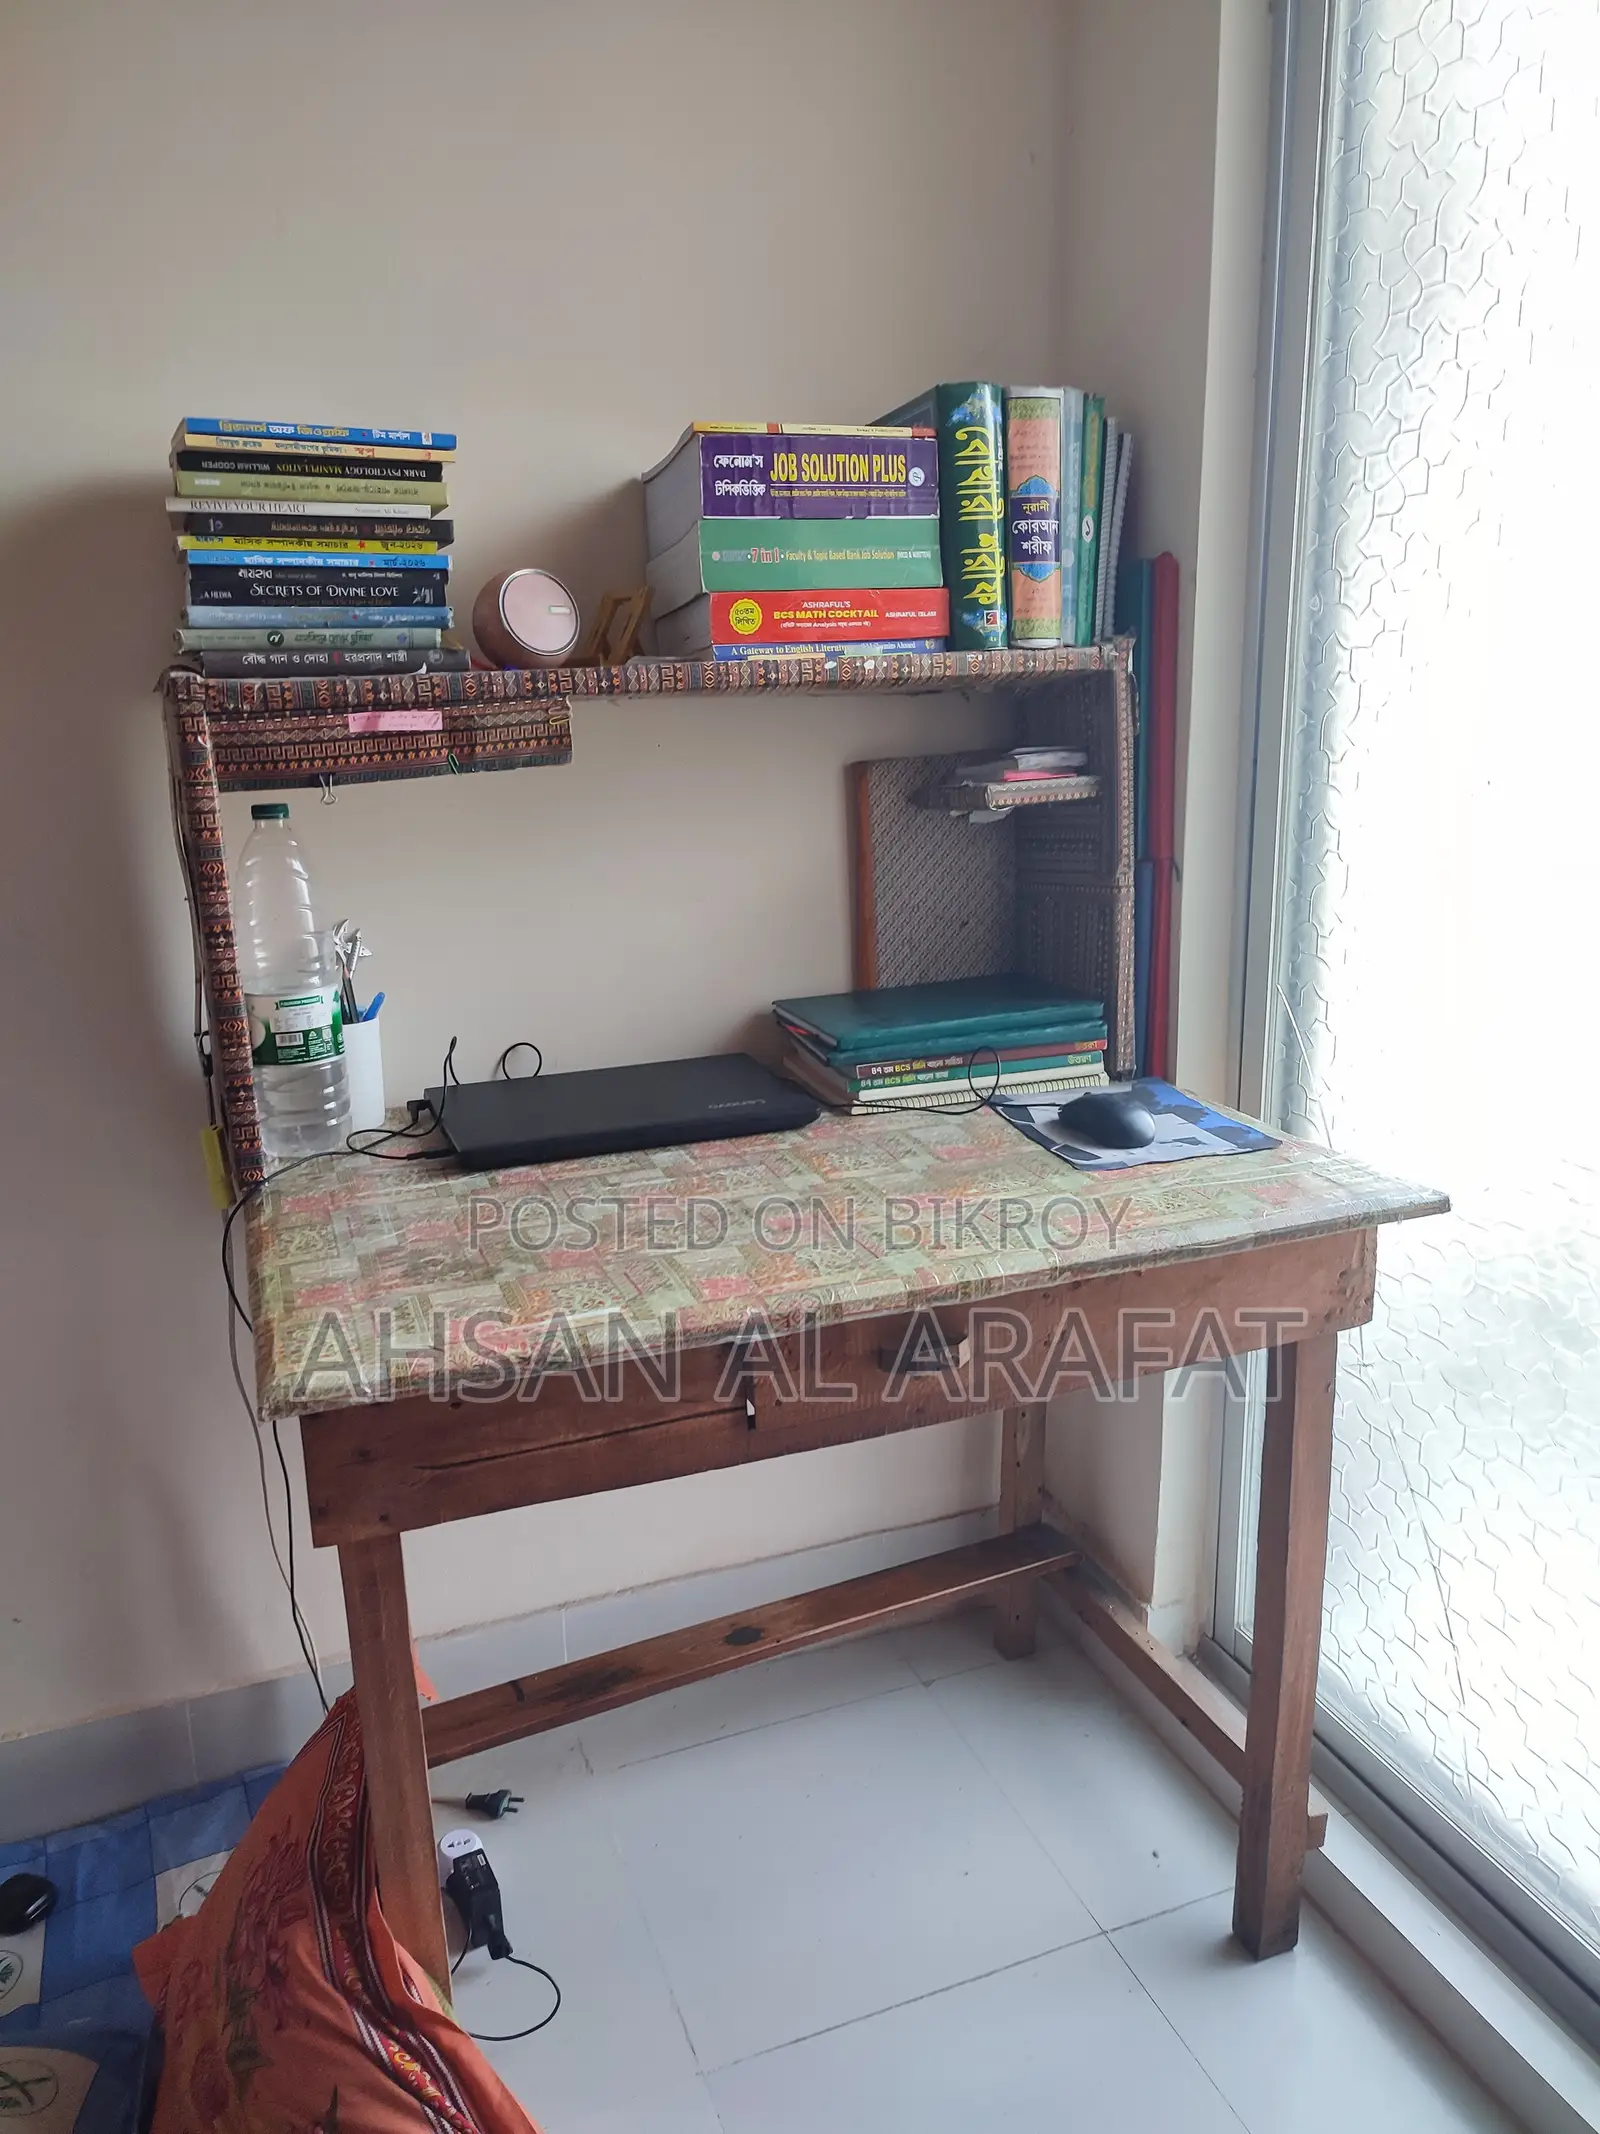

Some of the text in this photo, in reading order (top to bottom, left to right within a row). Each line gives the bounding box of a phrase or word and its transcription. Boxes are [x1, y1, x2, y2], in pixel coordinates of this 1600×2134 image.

[201, 460, 270, 471] WILLIAM COOPER
[276, 463, 426, 477] DARK PSYCHOLOGY MANIPULATION
[770, 453, 906, 483] JOB SOLUTION PLUS
[190, 501, 307, 514] REVIVE YOUR HEART
[954, 426, 1005, 605] বোখারী শরীফ
[1012, 518, 1059, 535] কোরআন
[1021, 536, 1053, 556] শরীফ
[750, 547, 759, 563] 7
[760, 547, 773, 563] in
[250, 583, 399, 597] SECRETS OF DIVINE LOVE
[802, 601, 851, 609] ASHRAFUL'S
[773, 609, 879, 619] BCS MATH COCKTAIL
[731, 647, 738, 655] A
[740, 645, 774, 655] Gateway
[776, 645, 784, 653] to
[785, 644, 814, 653] English
[243, 652, 328, 664] বৌদ্ধ গান ও দোহা
[344, 652, 382, 663] হরপ্রসাদ
[895, 1063, 911, 1072] BCS
[884, 1076, 901, 1085] BCS
